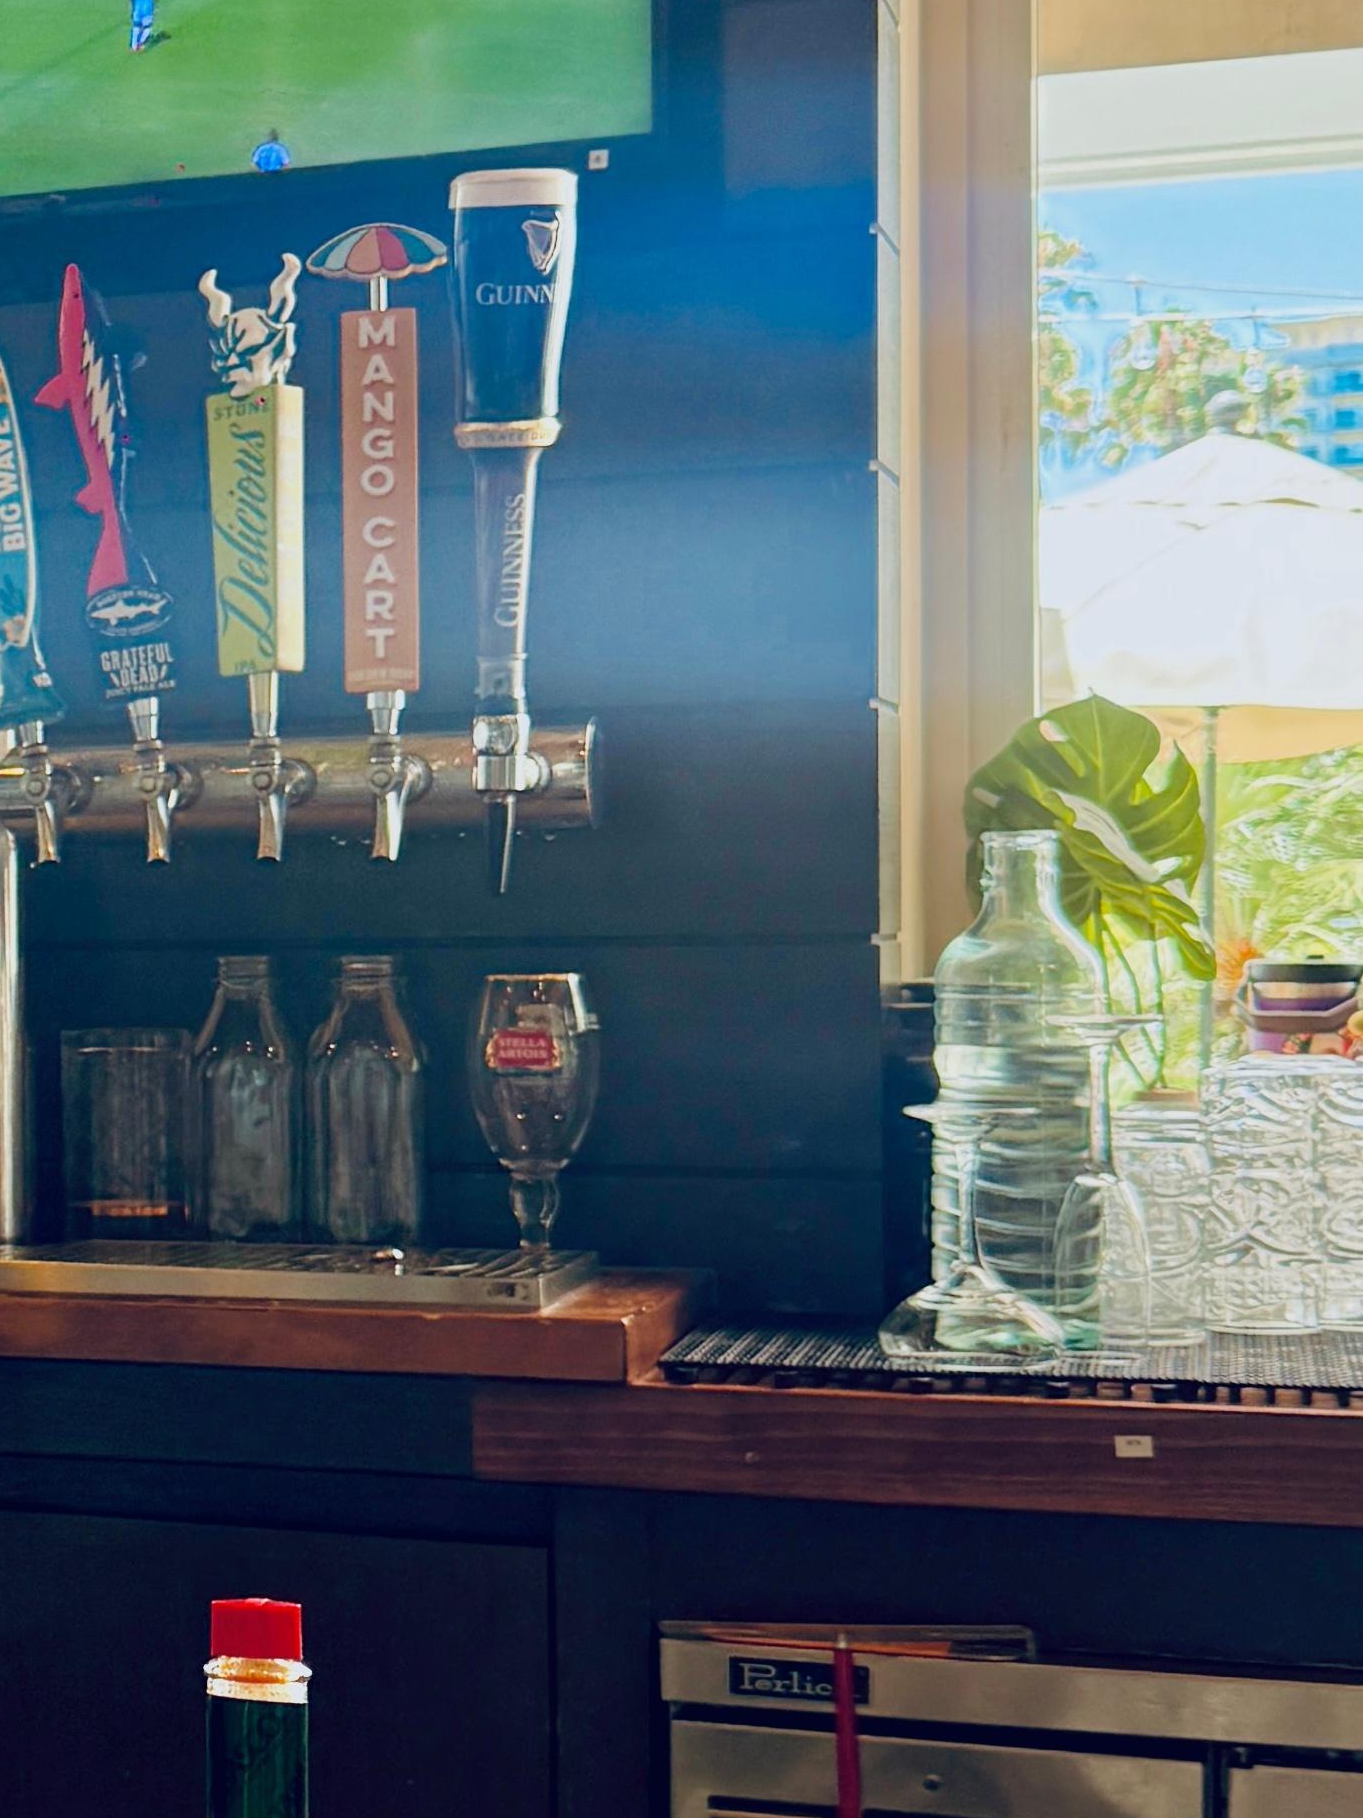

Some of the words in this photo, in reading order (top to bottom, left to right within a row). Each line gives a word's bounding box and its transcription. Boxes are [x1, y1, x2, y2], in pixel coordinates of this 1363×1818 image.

[357, 317, 396, 497] MANGO
[213, 423, 273, 657] Delicious
[494, 493, 525, 627] GUINNESS
[361, 516, 396, 659] CART
[101, 643, 173, 672] GRATEFUL
[120, 664, 158, 687] DEAD
[497, 1049, 547, 1059] ARTOIS
[498, 1037, 547, 1047] STELLA
[739, 1663, 861, 1698] Perlic
